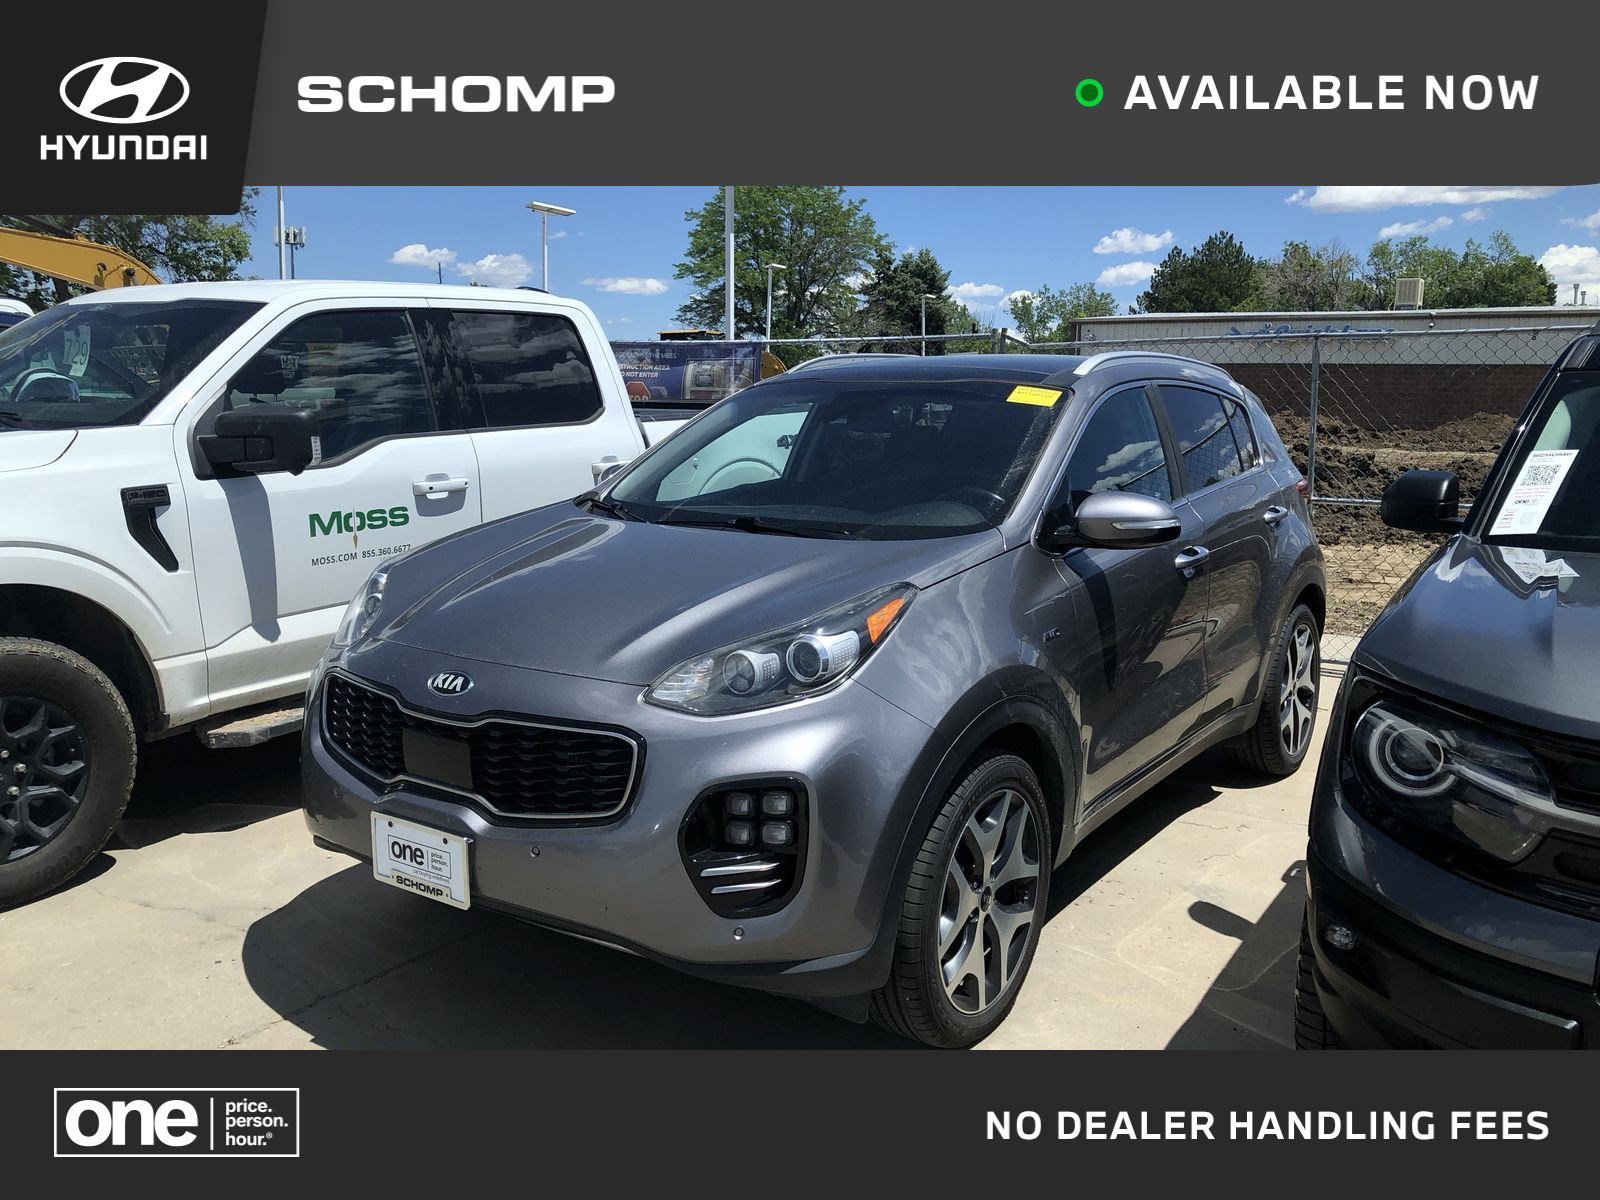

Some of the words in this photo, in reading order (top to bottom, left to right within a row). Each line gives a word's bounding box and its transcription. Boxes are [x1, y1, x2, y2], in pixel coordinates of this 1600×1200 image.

[308, 506, 410, 538] MOSS
[311, 552, 358, 567] MOSS.COM
[361, 543, 411, 559] 855.360.6677
[433, 673, 465, 692] KIA
[391, 840, 425, 866] one
[395, 875, 444, 898] SCHOMP
